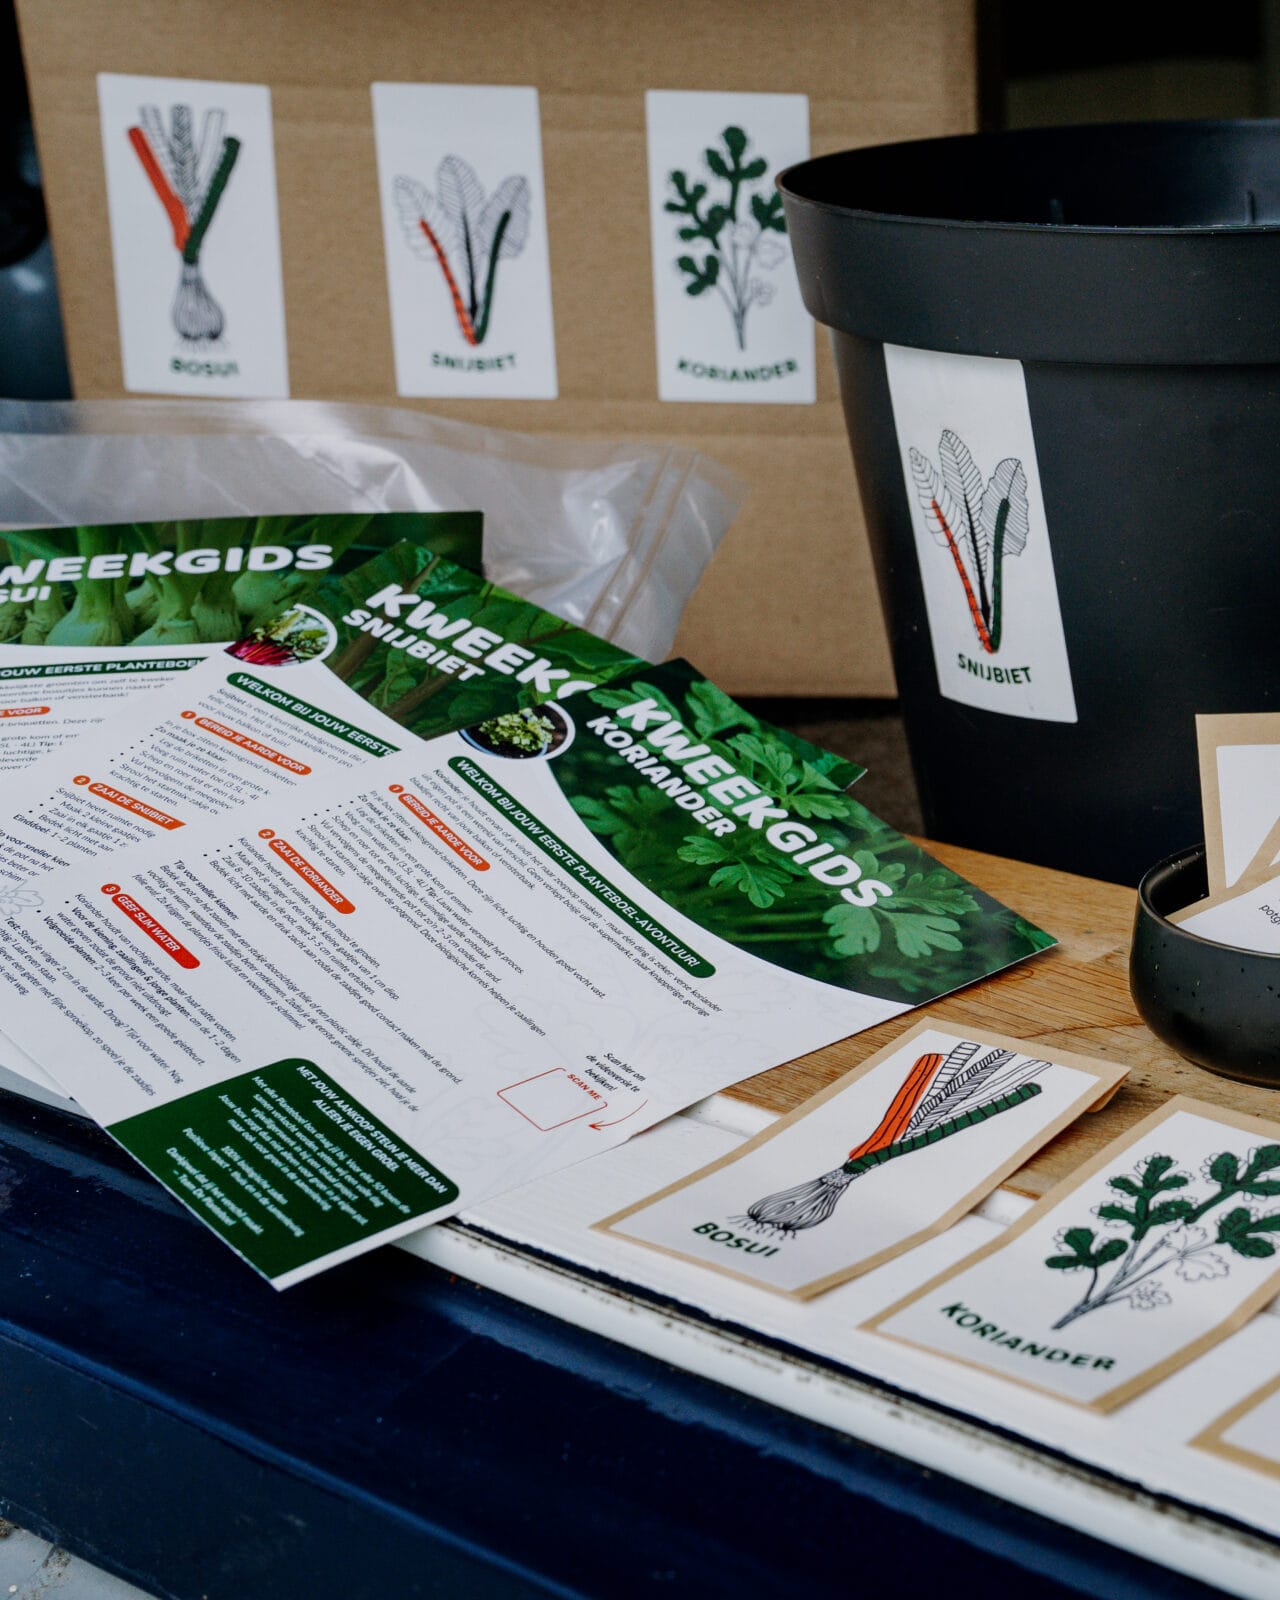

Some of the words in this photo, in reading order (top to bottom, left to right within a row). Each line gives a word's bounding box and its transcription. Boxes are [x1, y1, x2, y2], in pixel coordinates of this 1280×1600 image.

[171, 357, 239, 376] BOSUI
[677, 356, 797, 381] KORIANDER
[342, 609, 486, 681] SNIJBIET
[45, 663, 102, 675] EERSTE
[958, 653, 1032, 684] SNIJBIET
[8, 708, 42, 716] VOOR
[236, 674, 294, 707] WELKOM
[290, 702, 313, 716] BIJ
[307, 711, 351, 734] JOUW
[198, 716, 234, 738] BEREID
[231, 734, 246, 743] JE
[242, 740, 278, 759] AARDE
[276, 755, 306, 772] VOOR
[586, 715, 737, 837] KORIANDER
[55, 787, 87, 805] Snijbiet
[84, 801, 108, 815] heeft
[105, 812, 134, 828] ruimte
[132, 825, 157, 839] nodig
[92, 782, 120, 799] ZAAI
[116, 795, 134, 806] DE
[130, 802, 175, 825] SNIJBIET
[616, 698, 893, 907] KWEEKGIDS
[237, 836, 268, 864] Koriander
[402, 793, 431, 818] BEREID
[425, 817, 440, 826] JE
[433, 824, 464, 848] AARDE
[458, 844, 484, 866] VOOR
[263, 861, 283, 878] heeft
[272, 839, 296, 858] ZAAI
[289, 855, 306, 868] DE
[299, 865, 344, 905] KORIANDER
[278, 875, 294, 888] wat
[456, 759, 503, 799] WELKOM
[496, 796, 517, 811] BIJ
[508, 809, 545, 835] JOUW
[537, 833, 580, 867] EERSTE
[572, 864, 701, 968] PLANTEBOEL-AVONTUUR!
[173, 859, 186, 871] Tip
[182, 868, 200, 882] voor
[195, 881, 218, 900] sneller
[213, 898, 240, 921] kiemen:
[289, 886, 312, 905] ruimte
[117, 895, 141, 913] GEEF
[133, 911, 157, 929] SLIM
[151, 926, 181, 952] WATER
[221, 855, 240, 869] Zaai
[233, 866, 254, 883] 8–10
[248, 881, 273, 902] zaadjes
[268, 900, 279, 908] in
[275, 906, 287, 915] de
[281, 913, 298, 926] pot,
[294, 924, 311, 937] met
[307, 934, 324, 948] 3–5
[319, 946, 332, 956] cm
[327, 954, 351, 973] ruimte
[347, 971, 376, 996] ertussen.
[234, 850, 254, 867] Maak
[249, 865, 266, 879] met
[258, 875, 271, 884] je
[267, 882, 289, 899] vinger
[284, 898, 297, 906] of
[291, 905, 306, 917] een
[302, 915, 323, 932] stokje
[319, 930, 341, 948] kleine
[335, 946, 361, 966] gaatjes
[357, 964, 372, 976] van
[373, 979, 386, 989] cm
[383, 987, 400, 1002] diep.
[307, 903, 328, 921] nodig
[324, 919, 337, 929] om
[333, 927, 354, 943] mooi
[348, 941, 359, 949] te
[208, 859, 231, 878] Bedek
[226, 876, 243, 890] licht
[238, 888, 255, 901] met
[249, 899, 270, 916] aarde
[266, 914, 278, 923] en
[273, 921, 292, 936] druk
[287, 933, 307, 950] zacht
[302, 947, 318, 960] aan
[313, 958, 335, 974] zodat
[330, 972, 342, 981] de
[338, 980, 364, 1000] zaadjes
[358, 999, 381, 1014] goed
[375, 1012, 402, 1033] contact
[397, 1031, 422, 1050] maken
[418, 1048, 435, 1061] met
[430, 1059, 443, 1068] de
[437, 1066, 464, 1086] grond.
[353, 947, 381, 969] groeien.
[71, 906, 89, 921] Voor
[84, 920, 96, 929] de
[91, 927, 118, 951] kieming,
[114, 949, 147, 977] zaailingen
[146, 980, 169, 997] jonge
[163, 995, 192, 1019] planten:
[189, 1017, 203, 1028] om
[199, 1026, 211, 1035] de
[207, 1034, 225, 1047] 1–2
[219, 1045, 242, 1064] dagen
[567, 1073, 590, 1091] SCAN
[588, 1089, 602, 1100] ME
[584, 1068, 618, 1092] bekijken!
[586, 1054, 597, 1062] de
[595, 1061, 633, 1088] videoversie
[630, 1084, 640, 1093] te
[603, 1052, 621, 1066] Scan
[622, 1063, 635, 1074] hier
[633, 1072, 646, 1082] om
[295, 1065, 319, 1081] MET
[310, 1079, 340, 1100] JOUW
[333, 1099, 376, 1132] AANKOOP
[369, 1130, 401, 1154] STEUN
[393, 1151, 410, 1161] JE
[402, 1157, 431, 1179] MEER
[423, 1175, 448, 1194] DAN
[311, 1099, 346, 1125] ALLEEN
[339, 1122, 355, 1132] JE
[347, 1129, 377, 1151] EIGEN
[693, 1222, 782, 1258] BOSUI
[940, 1302, 1116, 1370] KORIANDER
